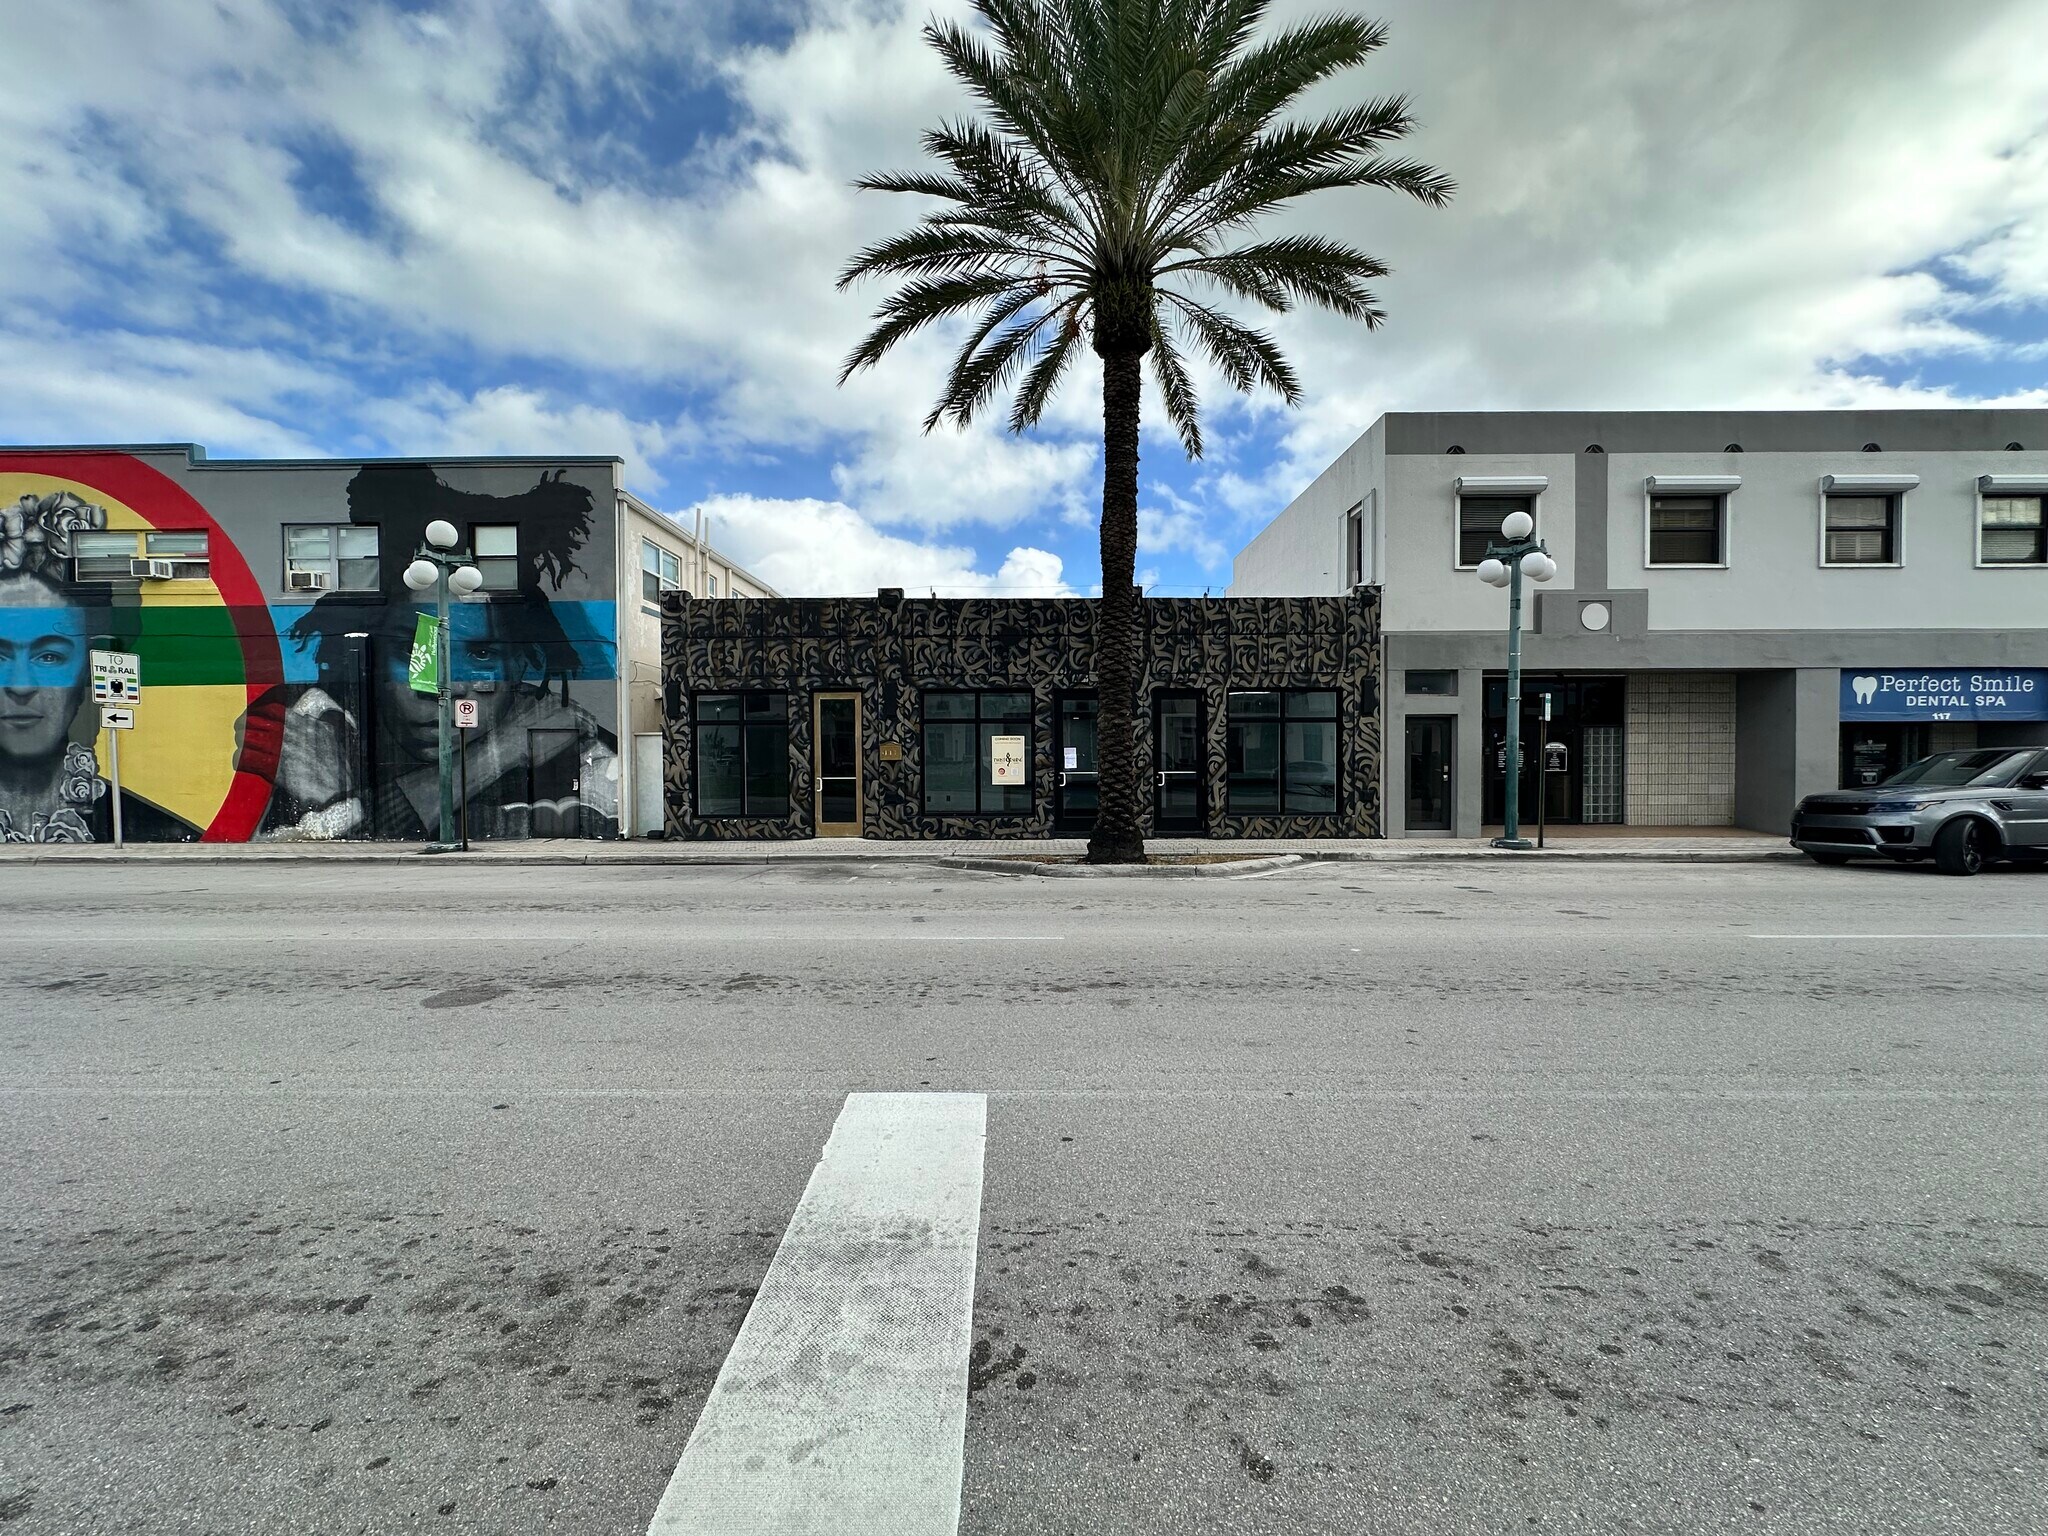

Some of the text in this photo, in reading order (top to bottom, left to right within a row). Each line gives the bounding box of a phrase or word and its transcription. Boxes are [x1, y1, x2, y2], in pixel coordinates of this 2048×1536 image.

[107, 655, 123, 665] TO
[1880, 675, 2034, 692] Perfect Smile
[1906, 696, 2006, 706] DENTAL SPA
[1932, 712, 1951, 720] 117
